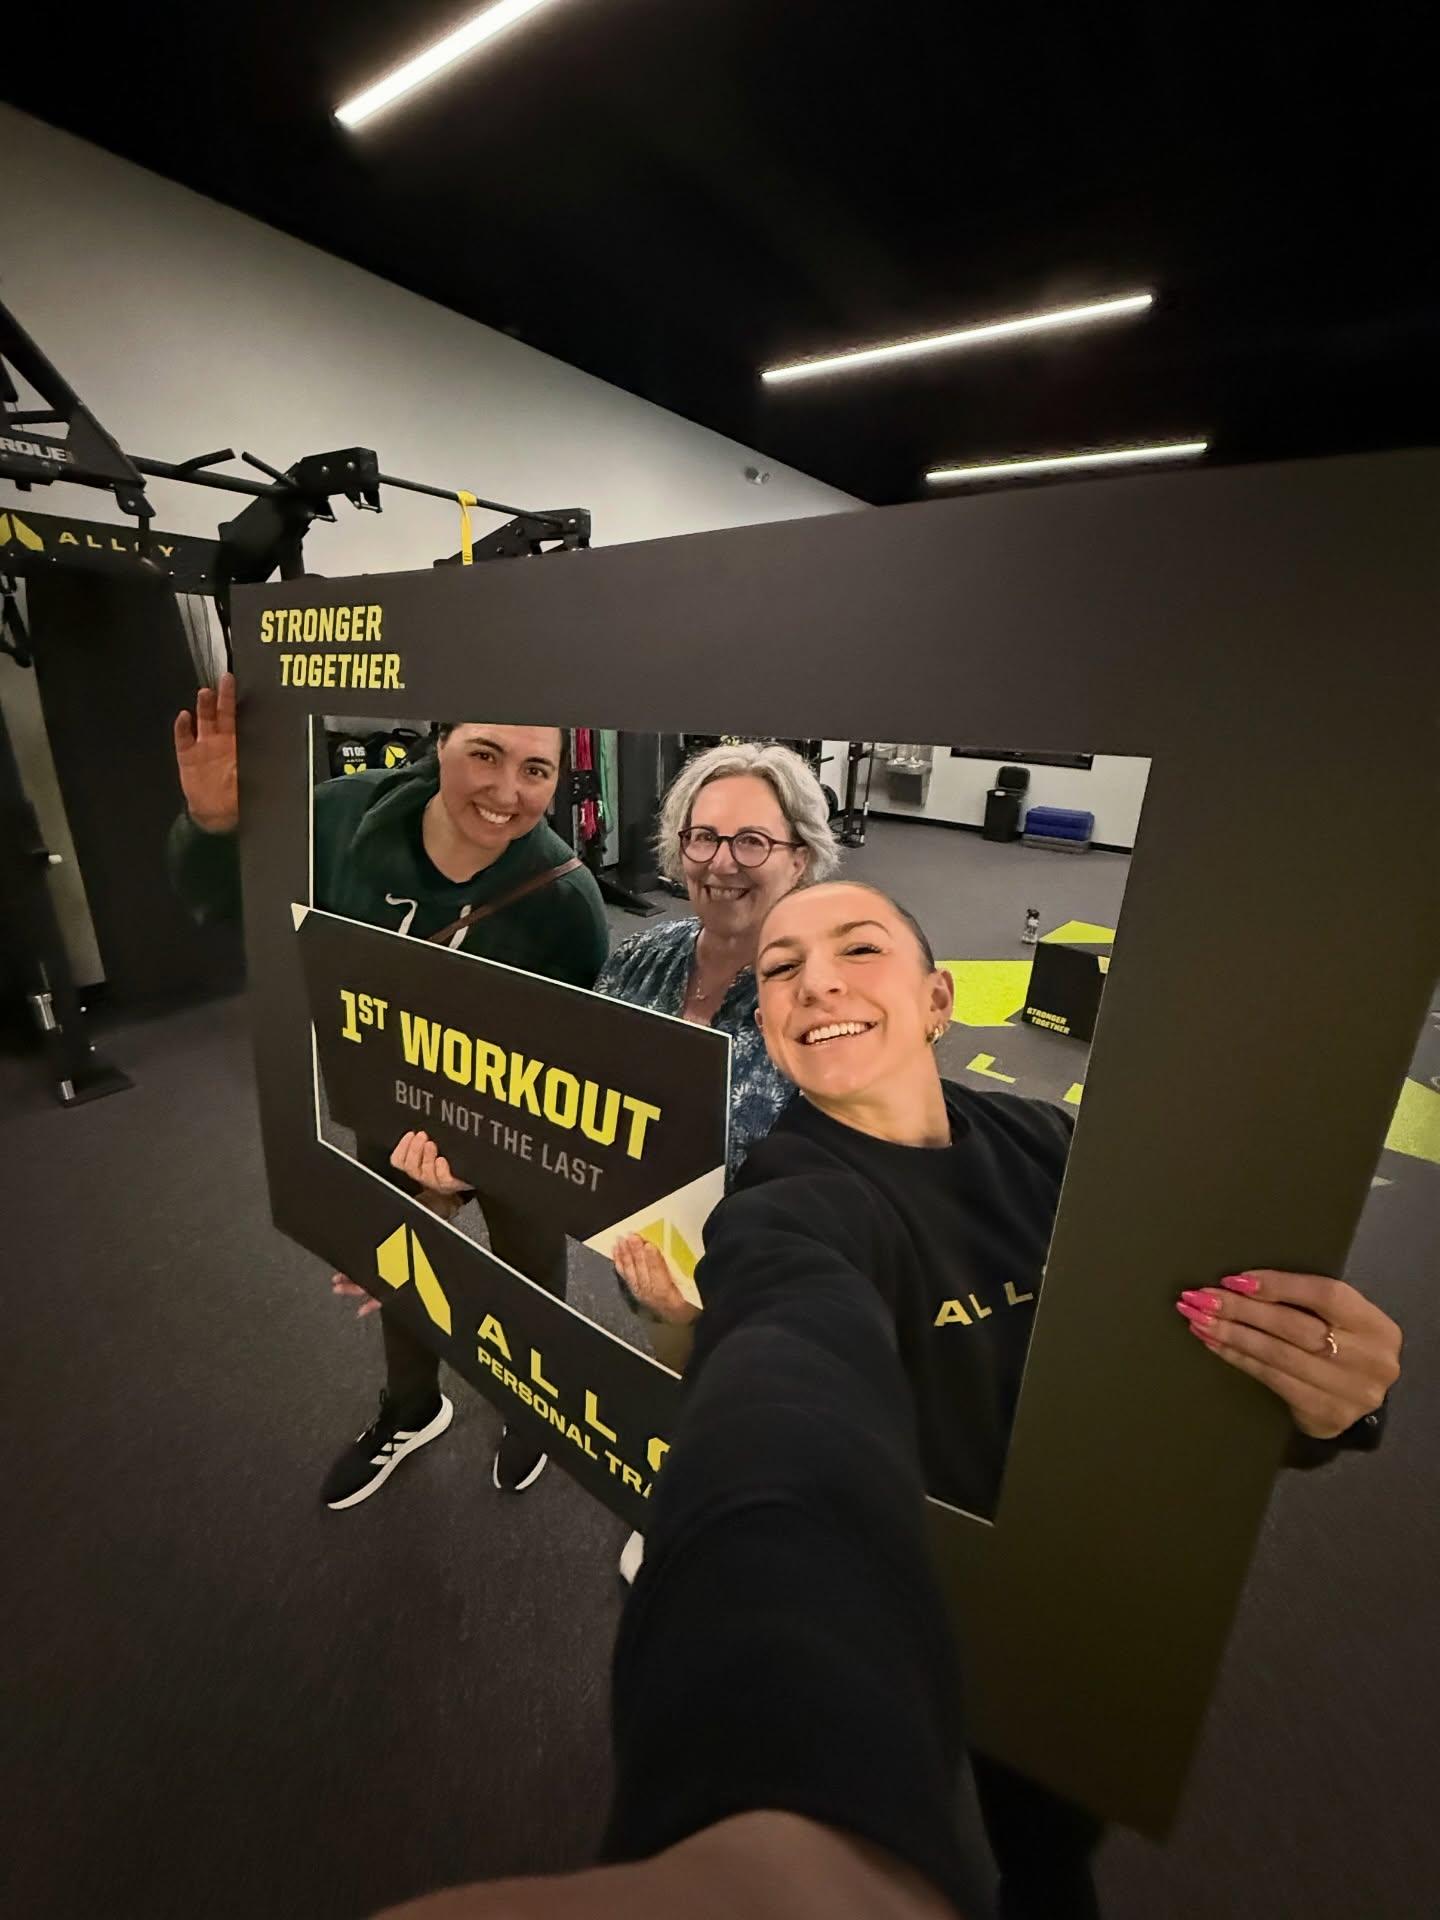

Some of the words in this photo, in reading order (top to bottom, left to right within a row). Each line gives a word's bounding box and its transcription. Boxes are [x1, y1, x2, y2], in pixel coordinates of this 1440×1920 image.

[59, 531, 174, 557] ALLY
[260, 605, 383, 643] STRONGER
[1027, 1006, 1067, 1026] STRONGER
[1031, 1016, 1071, 1035] TOGETHER
[340, 989, 388, 1043] 1ST
[400, 1010, 661, 1161] WORKOUT
[395, 1080, 434, 1116] BUT
[441, 1099, 484, 1137] NOT
[490, 1119, 533, 1161] THE
[541, 1143, 603, 1192] LAST
[934, 1266, 1046, 1327] ALL
[477, 1345, 598, 1461] PERSONAL
